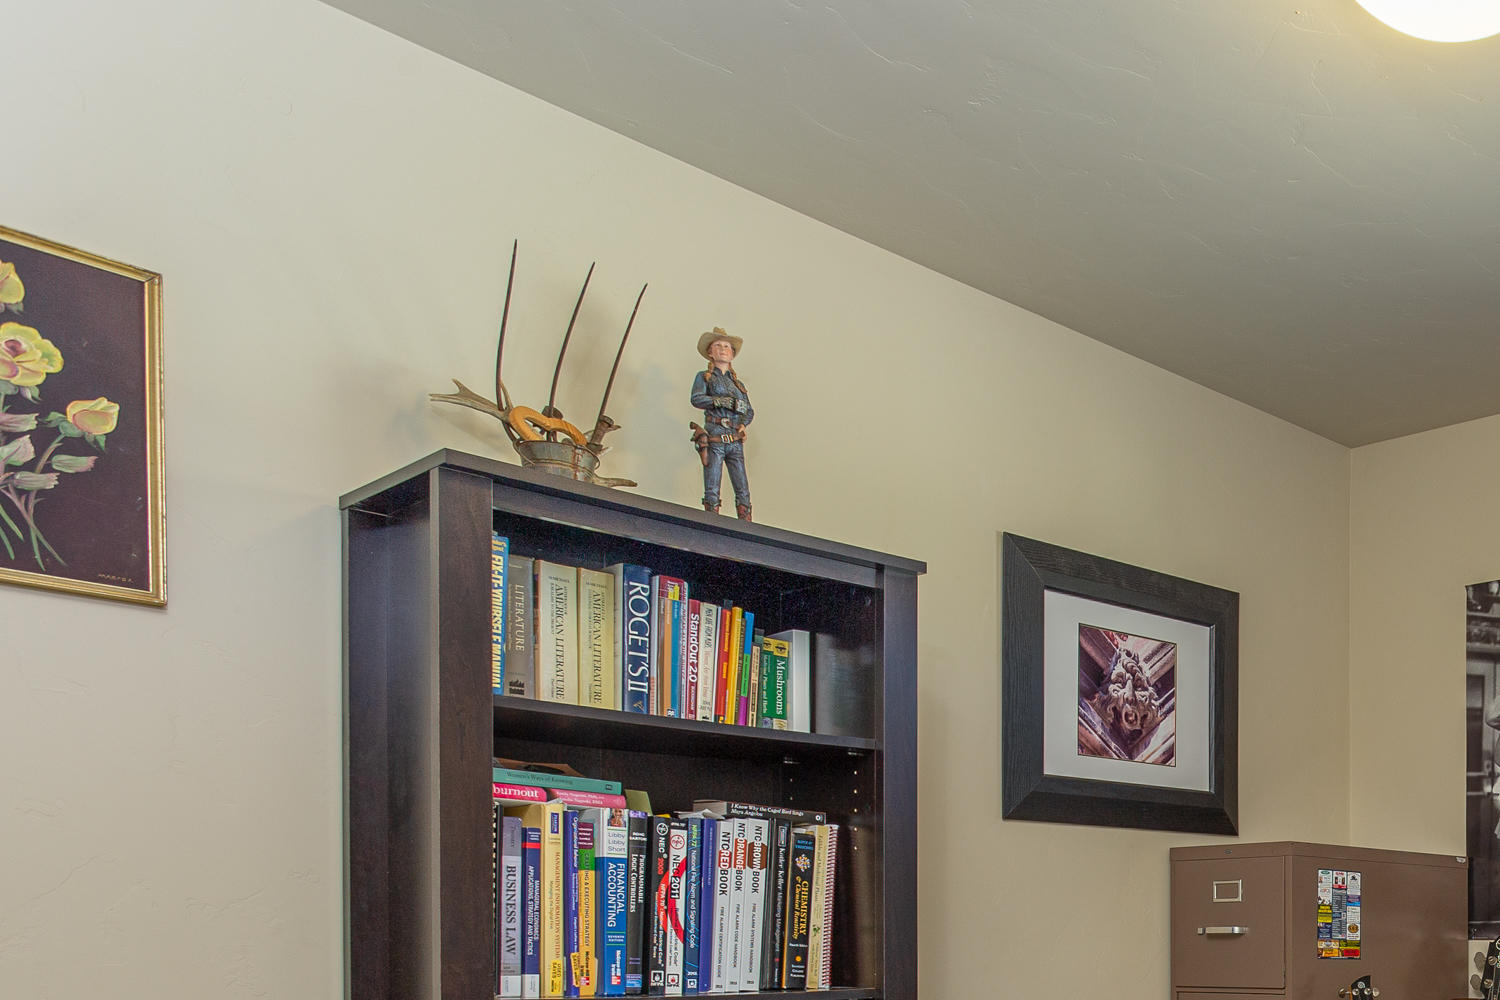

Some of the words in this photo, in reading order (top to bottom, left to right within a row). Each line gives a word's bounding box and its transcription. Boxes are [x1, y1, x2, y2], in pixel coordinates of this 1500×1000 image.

[514, 584, 525, 652] LITERATURE
[555, 583, 565, 636] AMERICAN
[592, 590, 602, 640] AMERICAN
[627, 581, 650, 677] ROGET'S
[688, 612, 700, 664] StandOut
[555, 637, 565, 700] LITERATURE
[593, 642, 602, 704] LITERATURE
[627, 678, 649, 695] II
[688, 665, 698, 683] 2.0
[776, 659, 785, 715] Mushrooms
[493, 785, 539, 798] burnout
[505, 865, 516, 924] BUSINESS
[607, 862, 616, 927] ACCOUNTING
[616, 863, 625, 914] FINANCIAL
[638, 854, 646, 904] PROGRAMMABLE
[671, 877, 680, 898] 2011
[792, 911, 800, 939] Reactivity
[800, 880, 809, 935] CHEMISTRY
[505, 926, 516, 956] LAW
